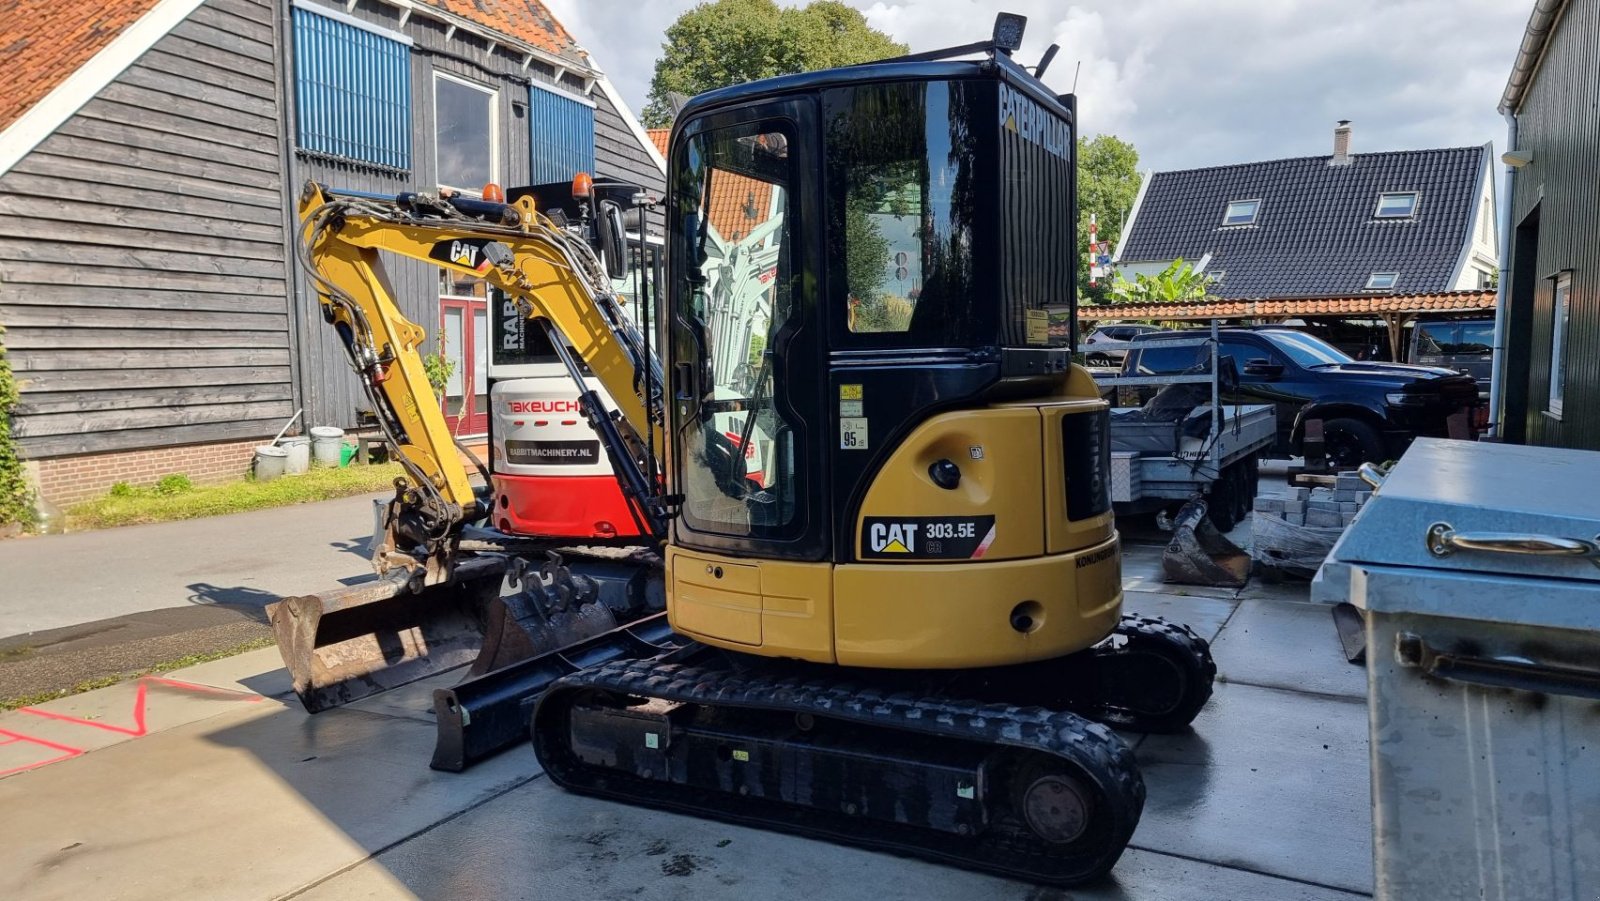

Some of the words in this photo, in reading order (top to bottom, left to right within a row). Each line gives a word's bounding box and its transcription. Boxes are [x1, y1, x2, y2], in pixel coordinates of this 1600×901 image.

[999, 81, 1071, 162] CATERPILLAR
[450, 240, 479, 268] CAT
[844, 431, 857, 447] 95
[509, 448, 593, 457] RABBITMACHINERY.NL
[870, 522, 918, 553] CAT
[926, 522, 976, 539] 303.5E
[926, 540, 943, 554] CR
